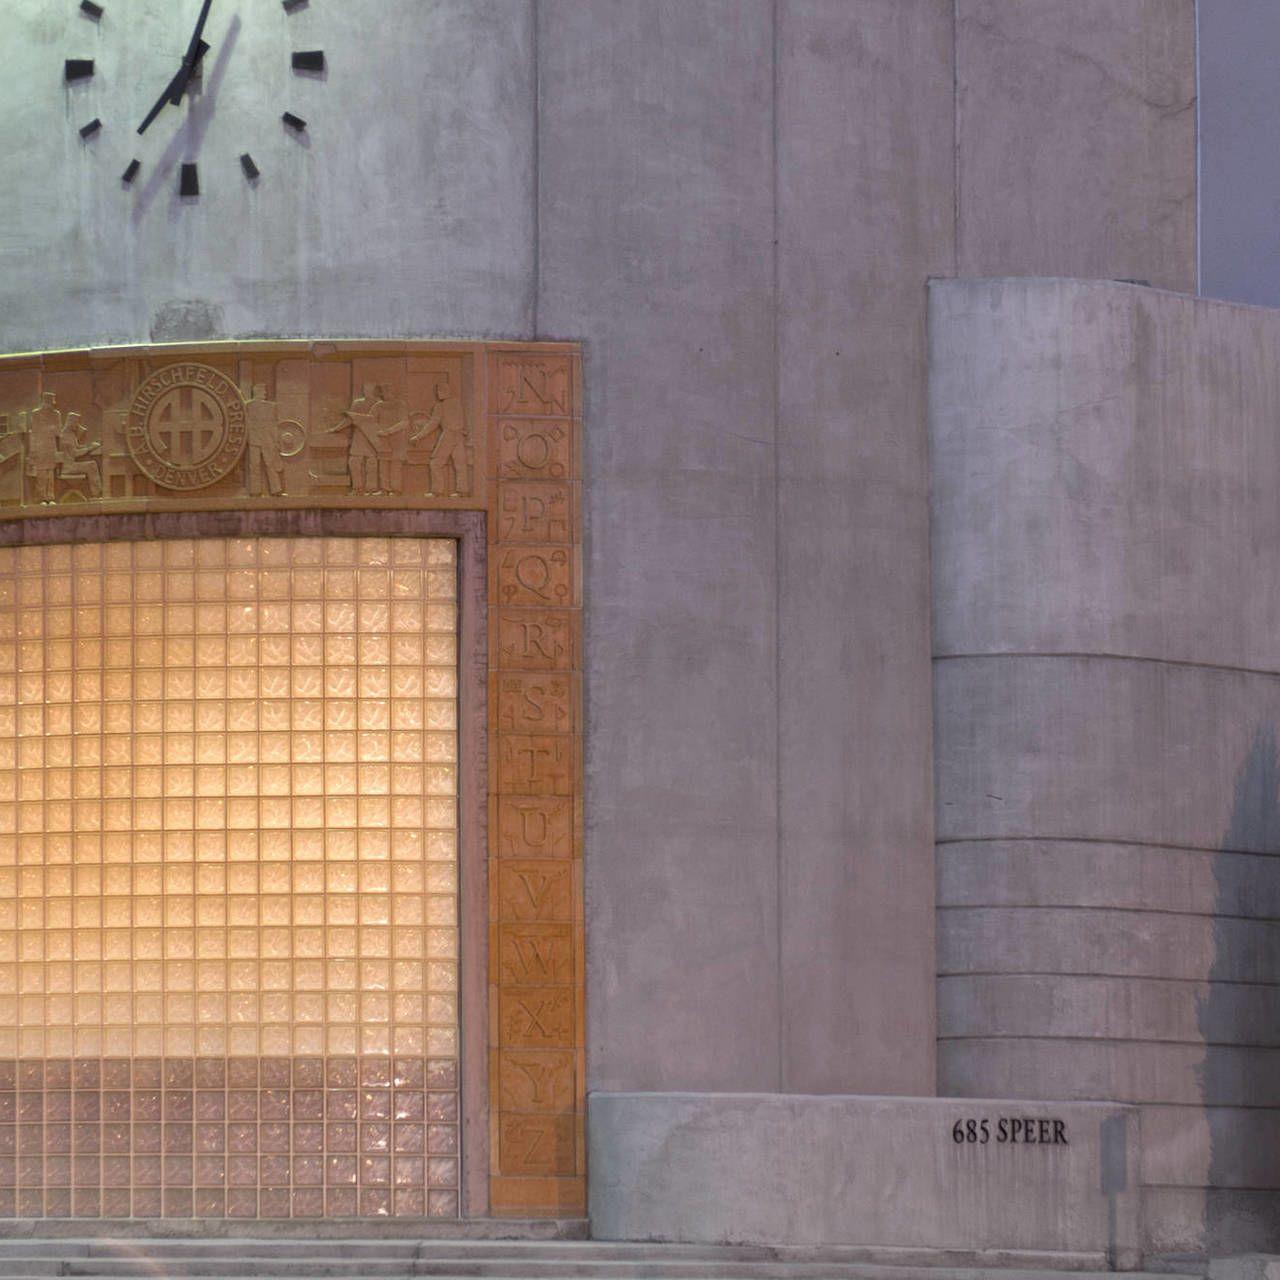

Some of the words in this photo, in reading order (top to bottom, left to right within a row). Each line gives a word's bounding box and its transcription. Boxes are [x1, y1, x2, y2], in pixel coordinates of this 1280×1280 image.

[516, 370, 550, 405] N
[131, 366, 229, 417] HIRSCHFELD
[224, 401, 245, 457] PRESS
[154, 463, 224, 487] DENVER
[521, 495, 546, 531] P
[515, 555, 553, 600] Q
[521, 623, 553, 660] R
[523, 686, 546, 721] S
[518, 749, 550, 783] T
[520, 811, 548, 847] U
[519, 874, 548, 909] V
[511, 939, 554, 976] W
[519, 1000, 554, 1038] X
[522, 1129, 552, 1165] Z
[952, 1119, 990, 1145] 685
[996, 1118, 1069, 1145] SPEER
